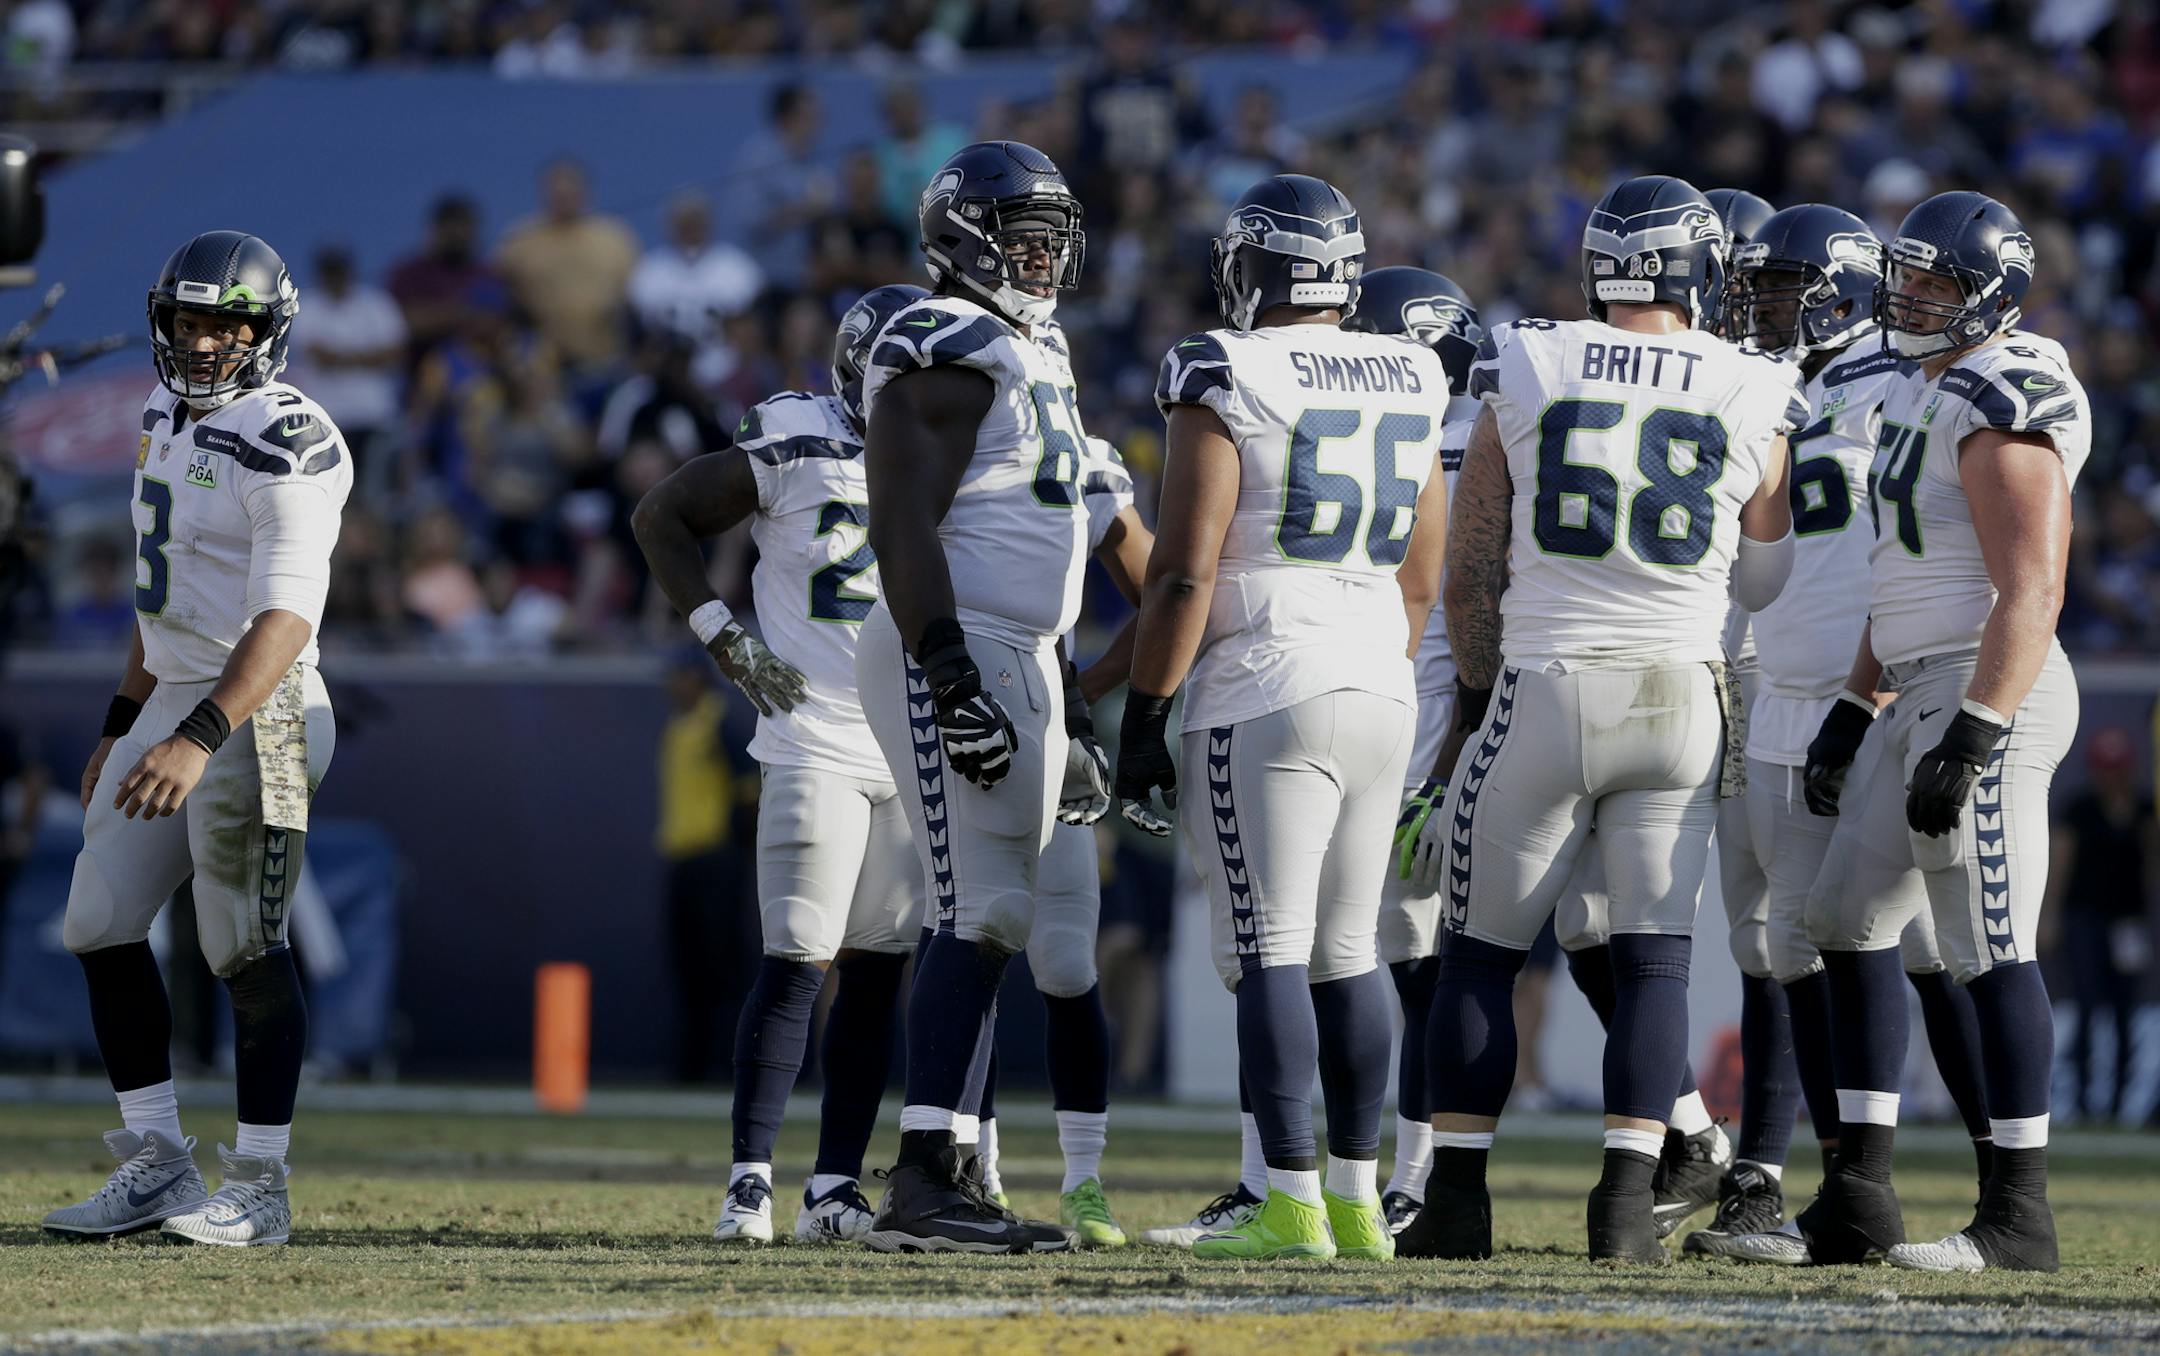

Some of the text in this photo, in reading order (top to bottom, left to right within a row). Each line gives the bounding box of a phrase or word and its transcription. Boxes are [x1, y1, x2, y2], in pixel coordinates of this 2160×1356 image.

[1290, 351, 1422, 393] SIMMONS
[1582, 342, 1702, 392] BRITT
[188, 463, 214, 484] PGA
[1273, 407, 1431, 567] 66
[1531, 397, 1731, 569] 68
[135, 474, 174, 619] 3
